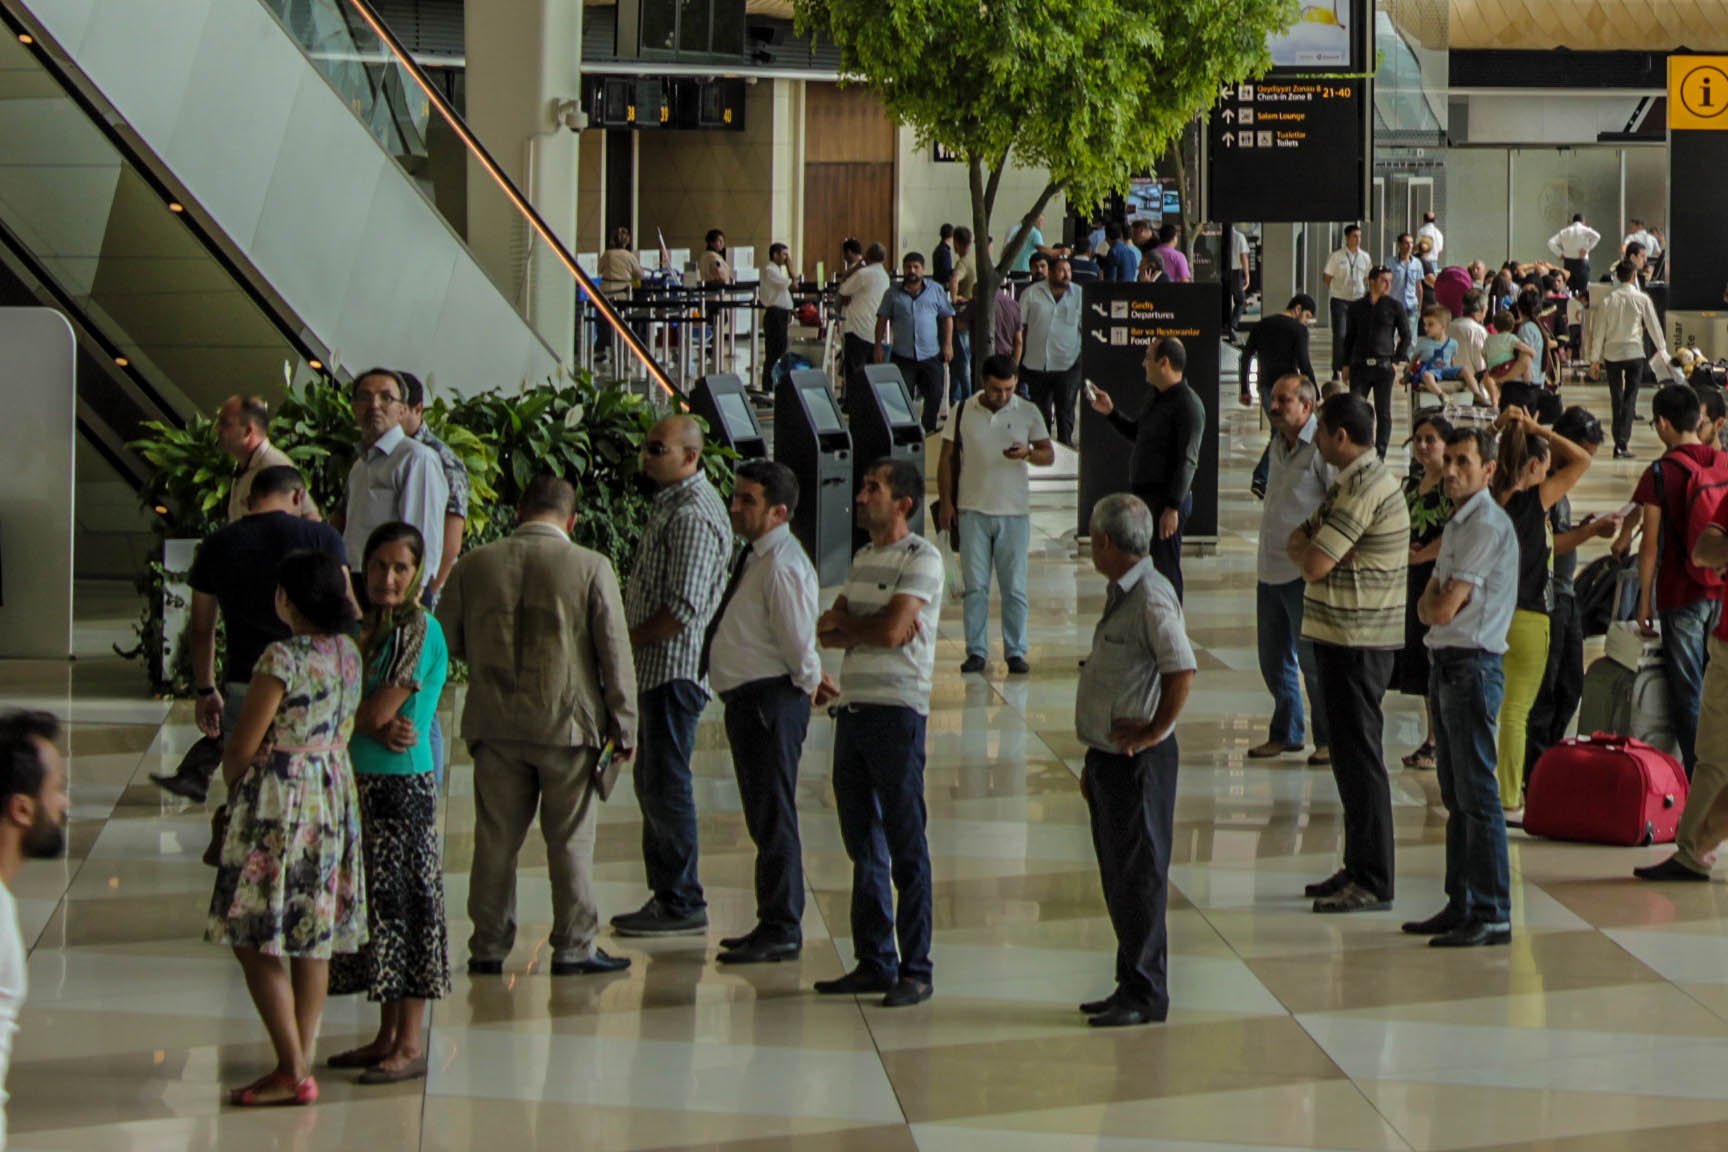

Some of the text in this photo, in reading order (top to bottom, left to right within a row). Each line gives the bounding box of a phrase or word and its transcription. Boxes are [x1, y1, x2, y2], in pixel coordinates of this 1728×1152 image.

[1257, 93, 1287, 101] Check-in
[1288, 93, 1306, 101] Zone
[1323, 87, 1351, 98] 21-40
[627, 105, 732, 123] 38 39 40
[1279, 112, 1305, 121] Lounge
[1277, 139, 1299, 147] Toilets
[1131, 311, 1174, 320] Departures
[1131, 337, 1151, 345] Food
